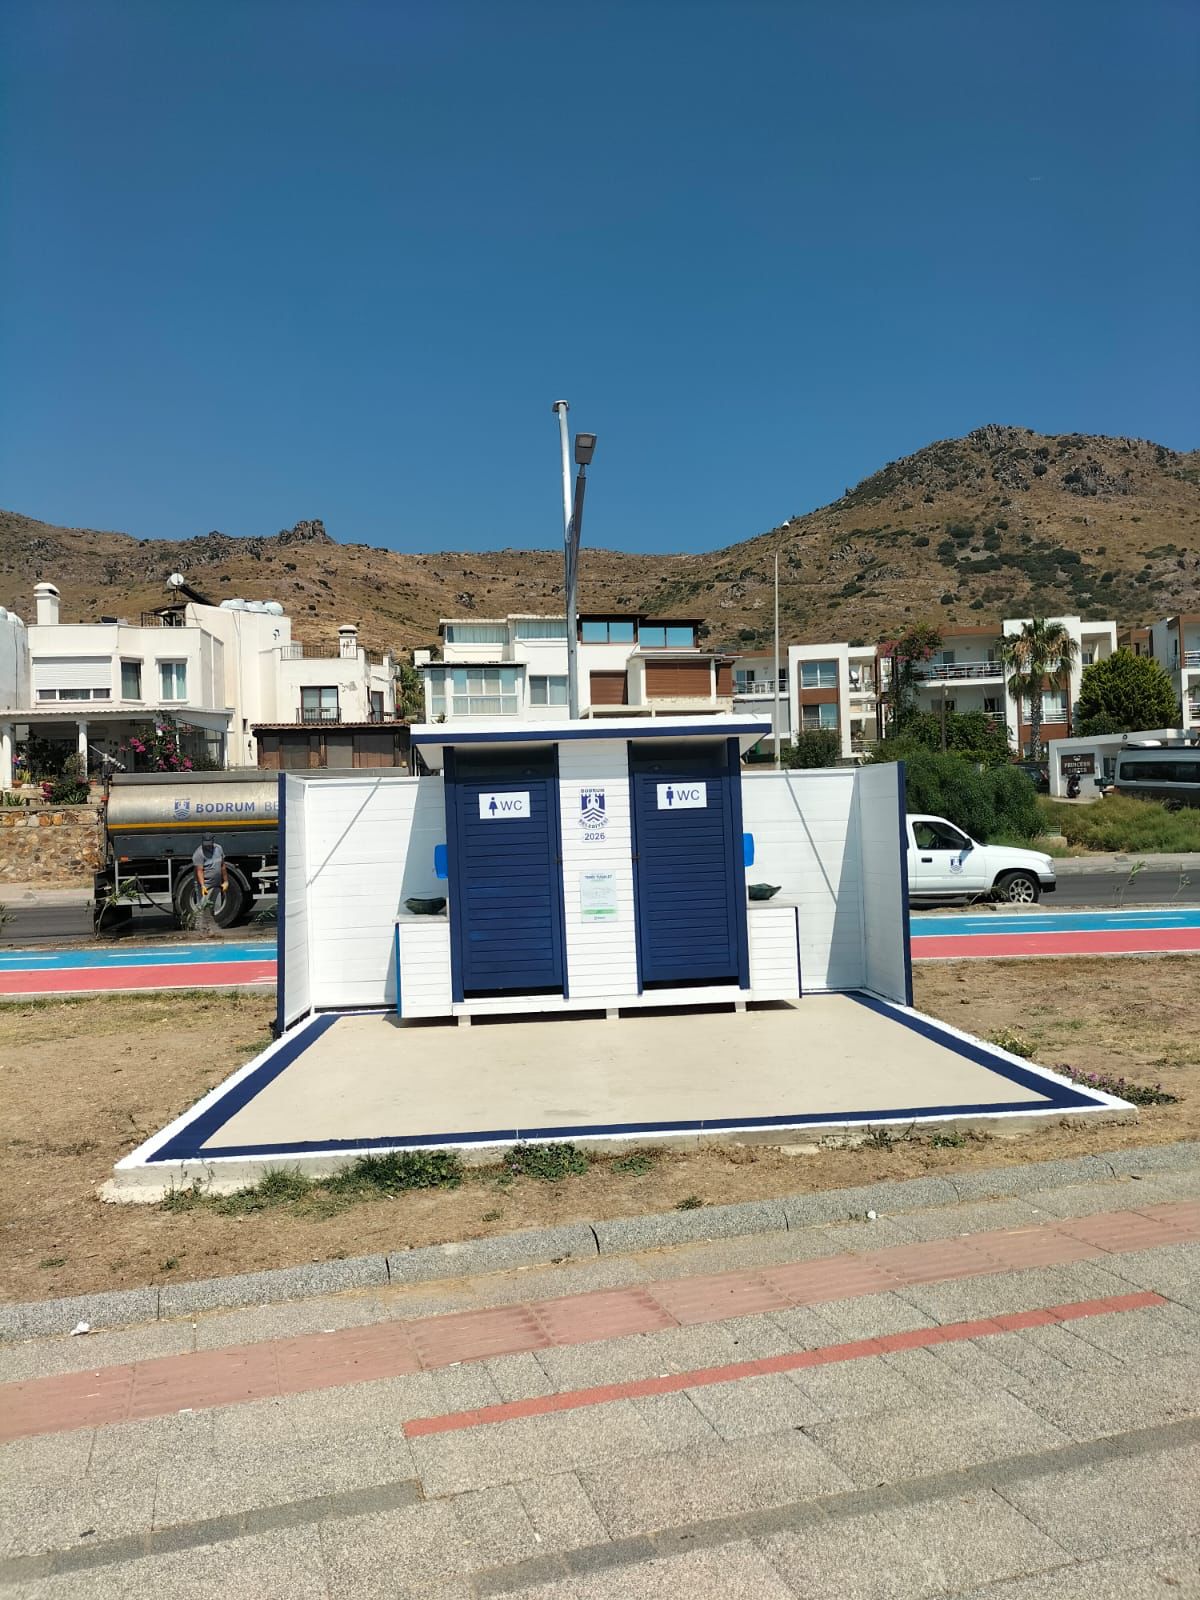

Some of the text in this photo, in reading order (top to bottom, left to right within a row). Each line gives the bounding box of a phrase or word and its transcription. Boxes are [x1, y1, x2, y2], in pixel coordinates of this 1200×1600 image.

[677, 789, 700, 801] WC
[195, 802, 255, 813] BODRUM
[500, 799, 523, 811] WC
[584, 832, 606, 841] 2026
